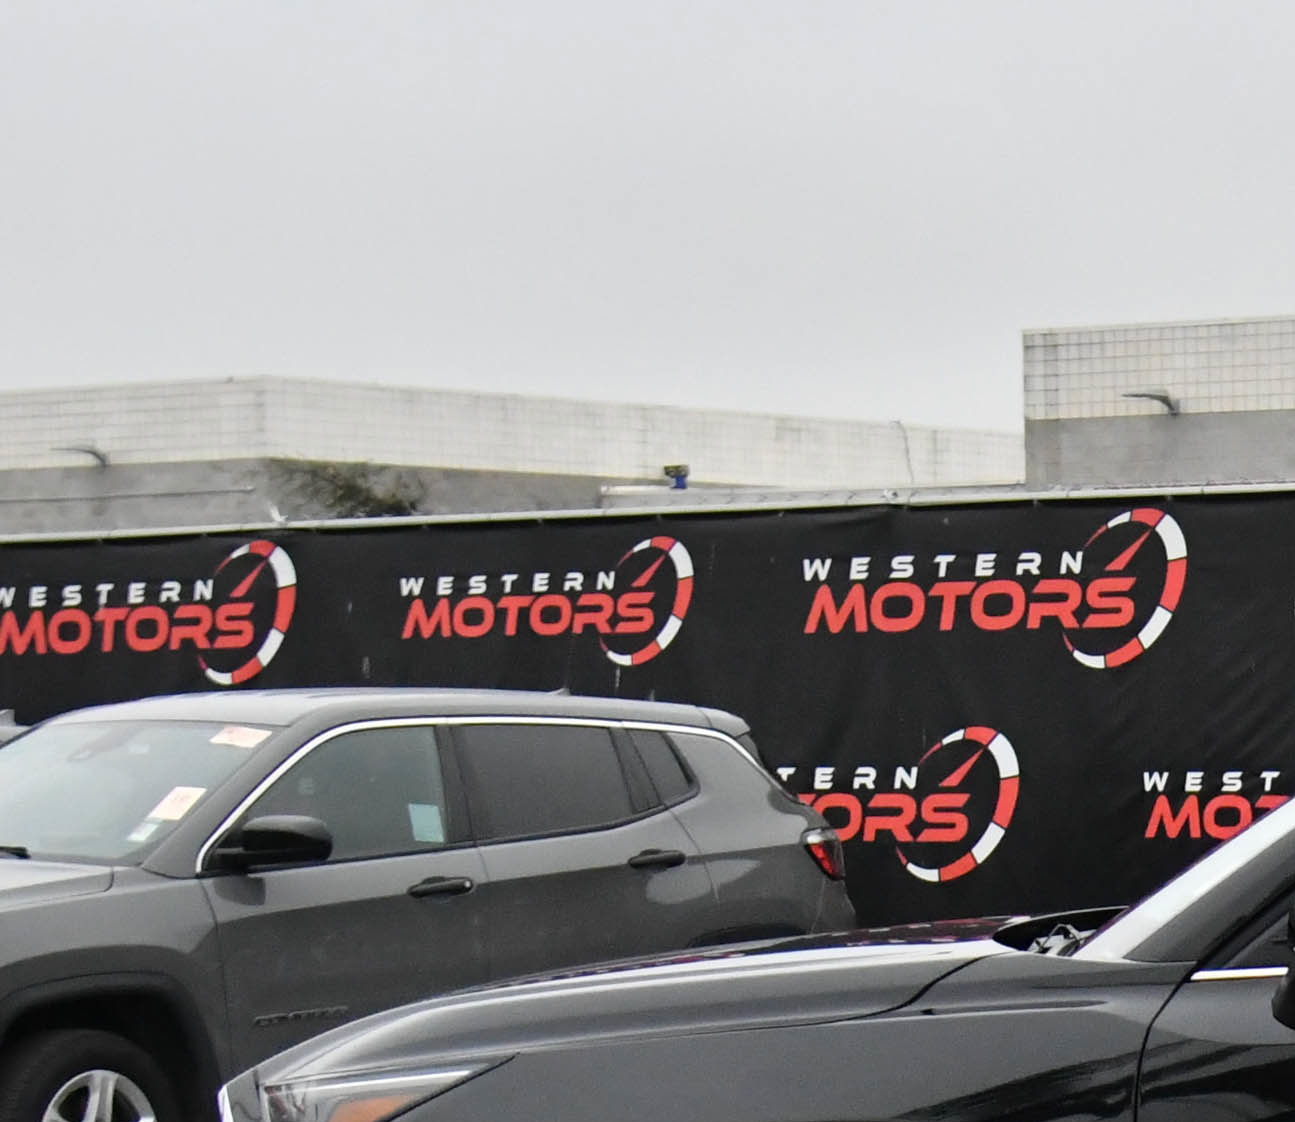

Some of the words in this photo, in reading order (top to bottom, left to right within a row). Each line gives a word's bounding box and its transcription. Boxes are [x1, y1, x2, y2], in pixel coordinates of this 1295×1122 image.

[400, 571, 615, 596] WESTERN
[803, 551, 1083, 581] WESTERN
[0, 579, 213, 607] WESTERN
[805, 577, 1136, 634] MOTORS
[0, 602, 254, 655] MOTORS
[402, 592, 654, 639] MOTORS
